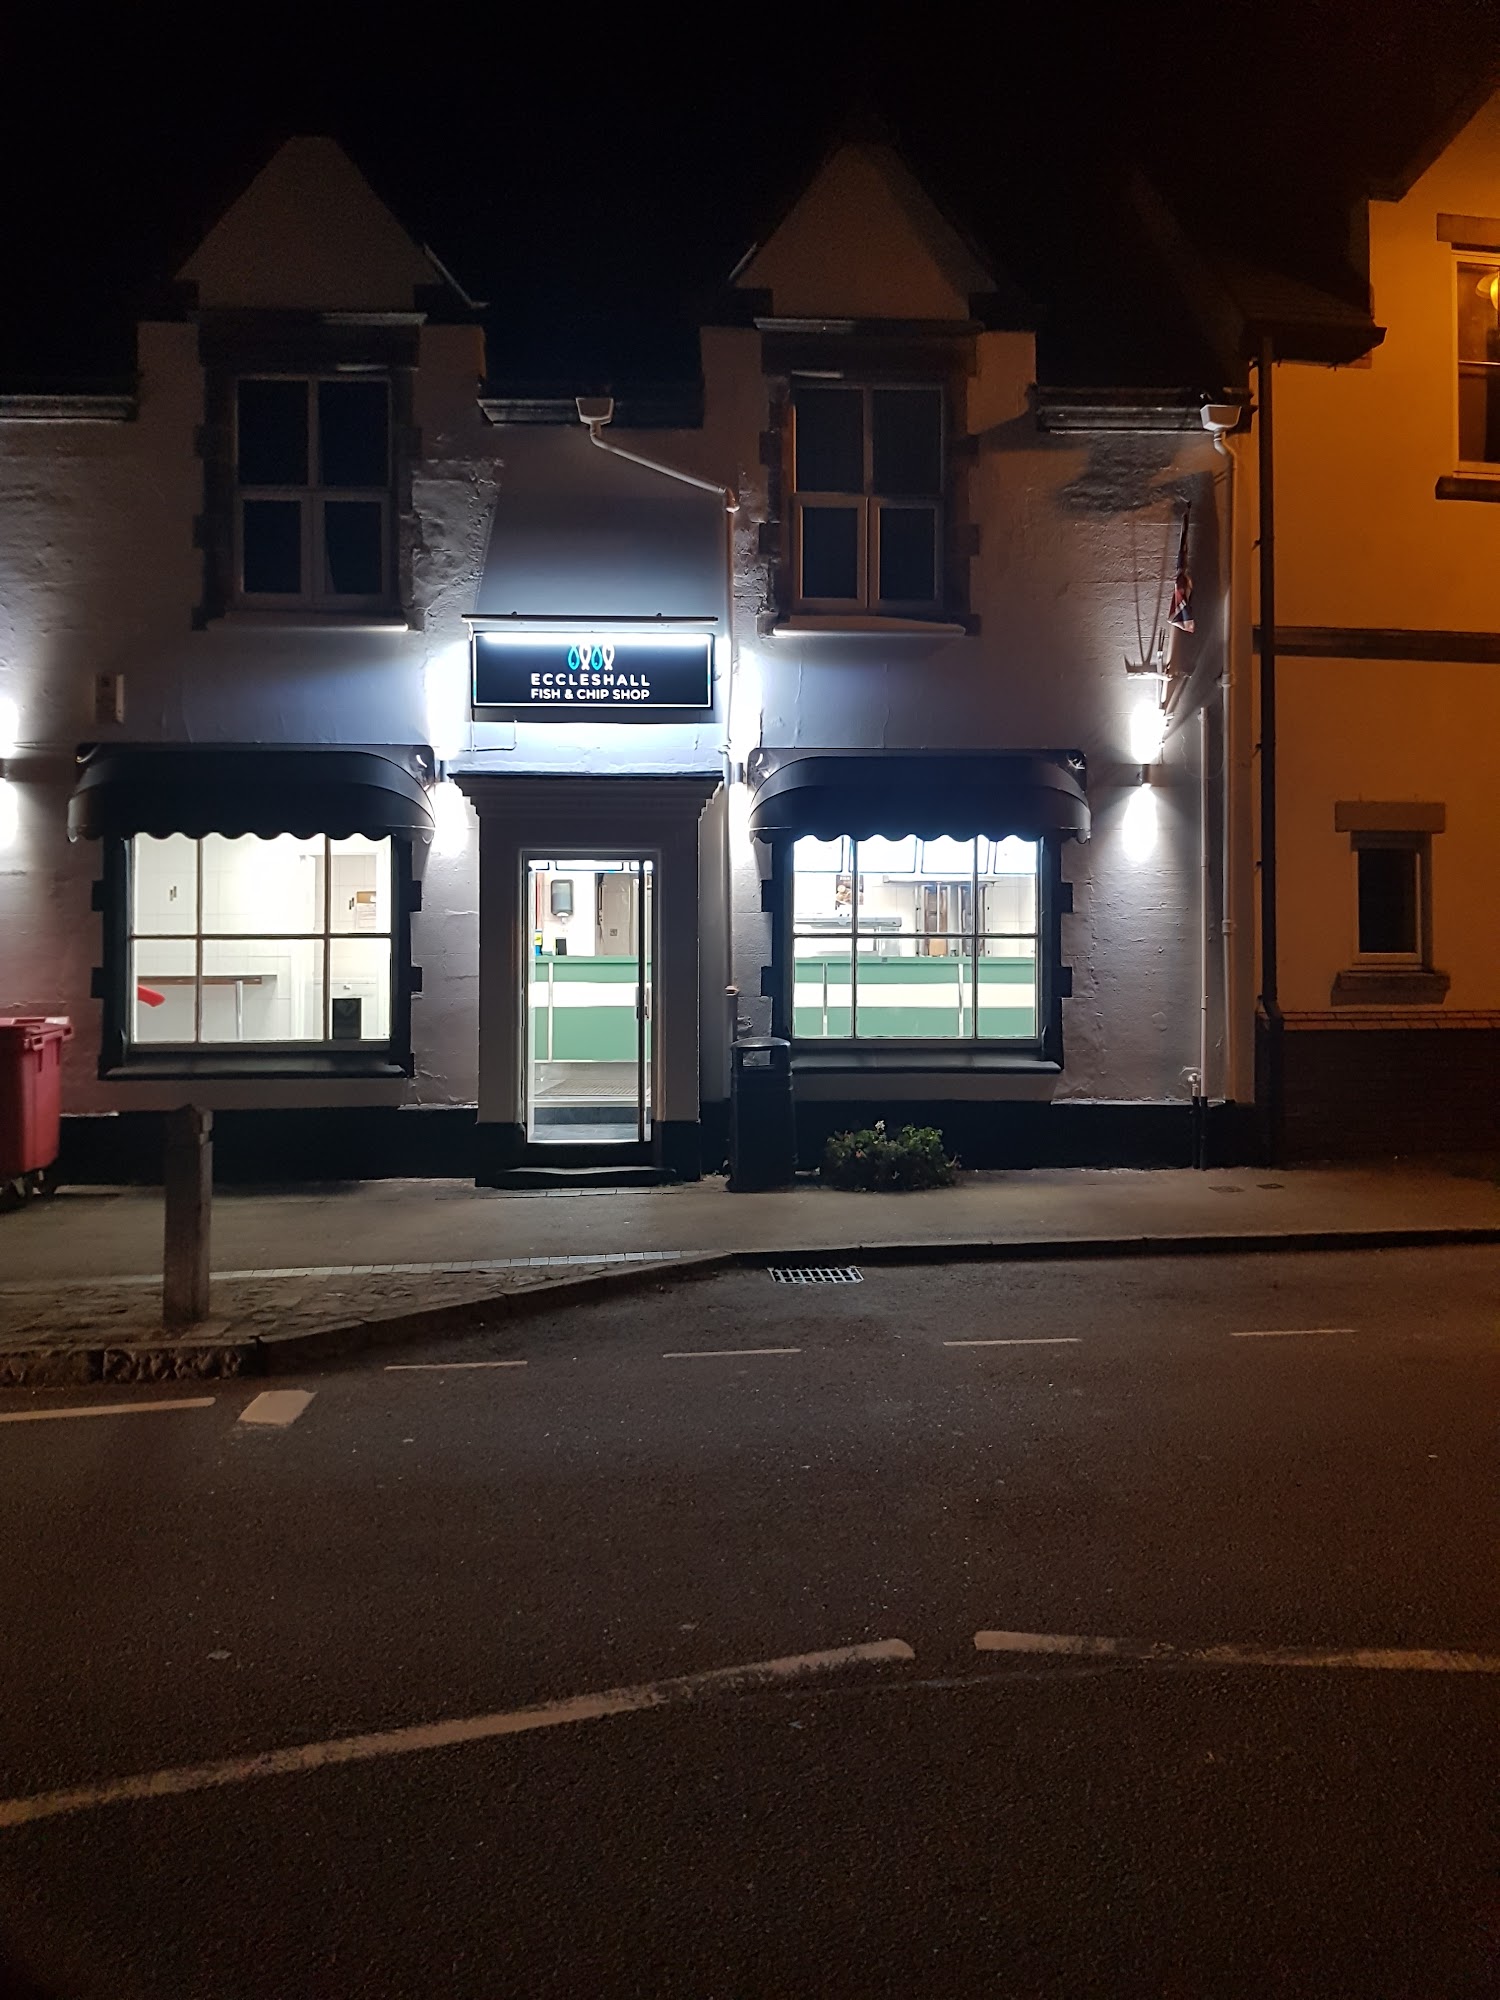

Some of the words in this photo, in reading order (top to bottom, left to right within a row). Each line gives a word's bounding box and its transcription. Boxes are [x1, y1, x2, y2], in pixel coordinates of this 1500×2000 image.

[531, 673, 650, 686] ECCLESHALL
[531, 689, 560, 699] FISH
[564, 689, 574, 700] &
[576, 689, 609, 700] CHIP
[612, 689, 650, 700] SHOP
